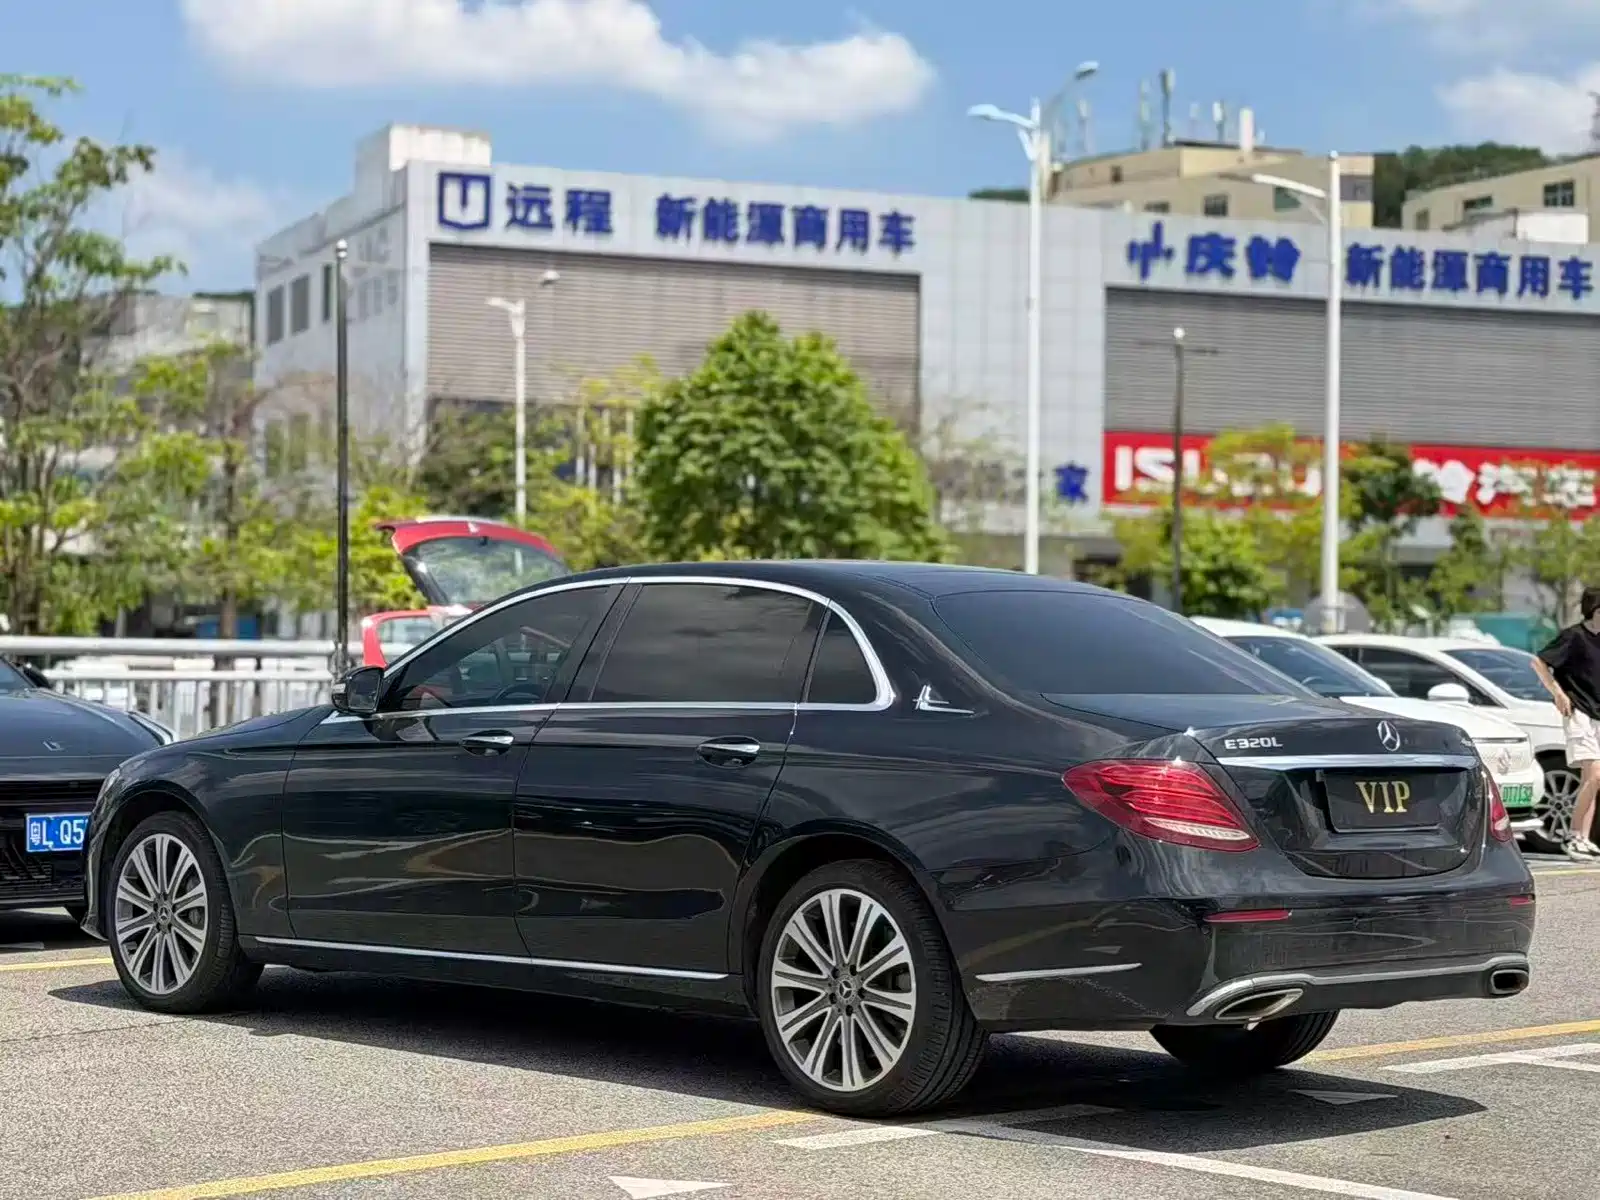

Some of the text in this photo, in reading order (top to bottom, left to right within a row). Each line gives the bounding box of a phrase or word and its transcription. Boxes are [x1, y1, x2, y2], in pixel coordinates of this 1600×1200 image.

[505, 183, 916, 258] 远程 新能源商用车
[1346, 242, 1594, 300] 新能源商用车
[1224, 736, 1284, 750] E320L
[1355, 780, 1411, 813] VIP
[30, 819, 89, 846] 粤L·Q5
